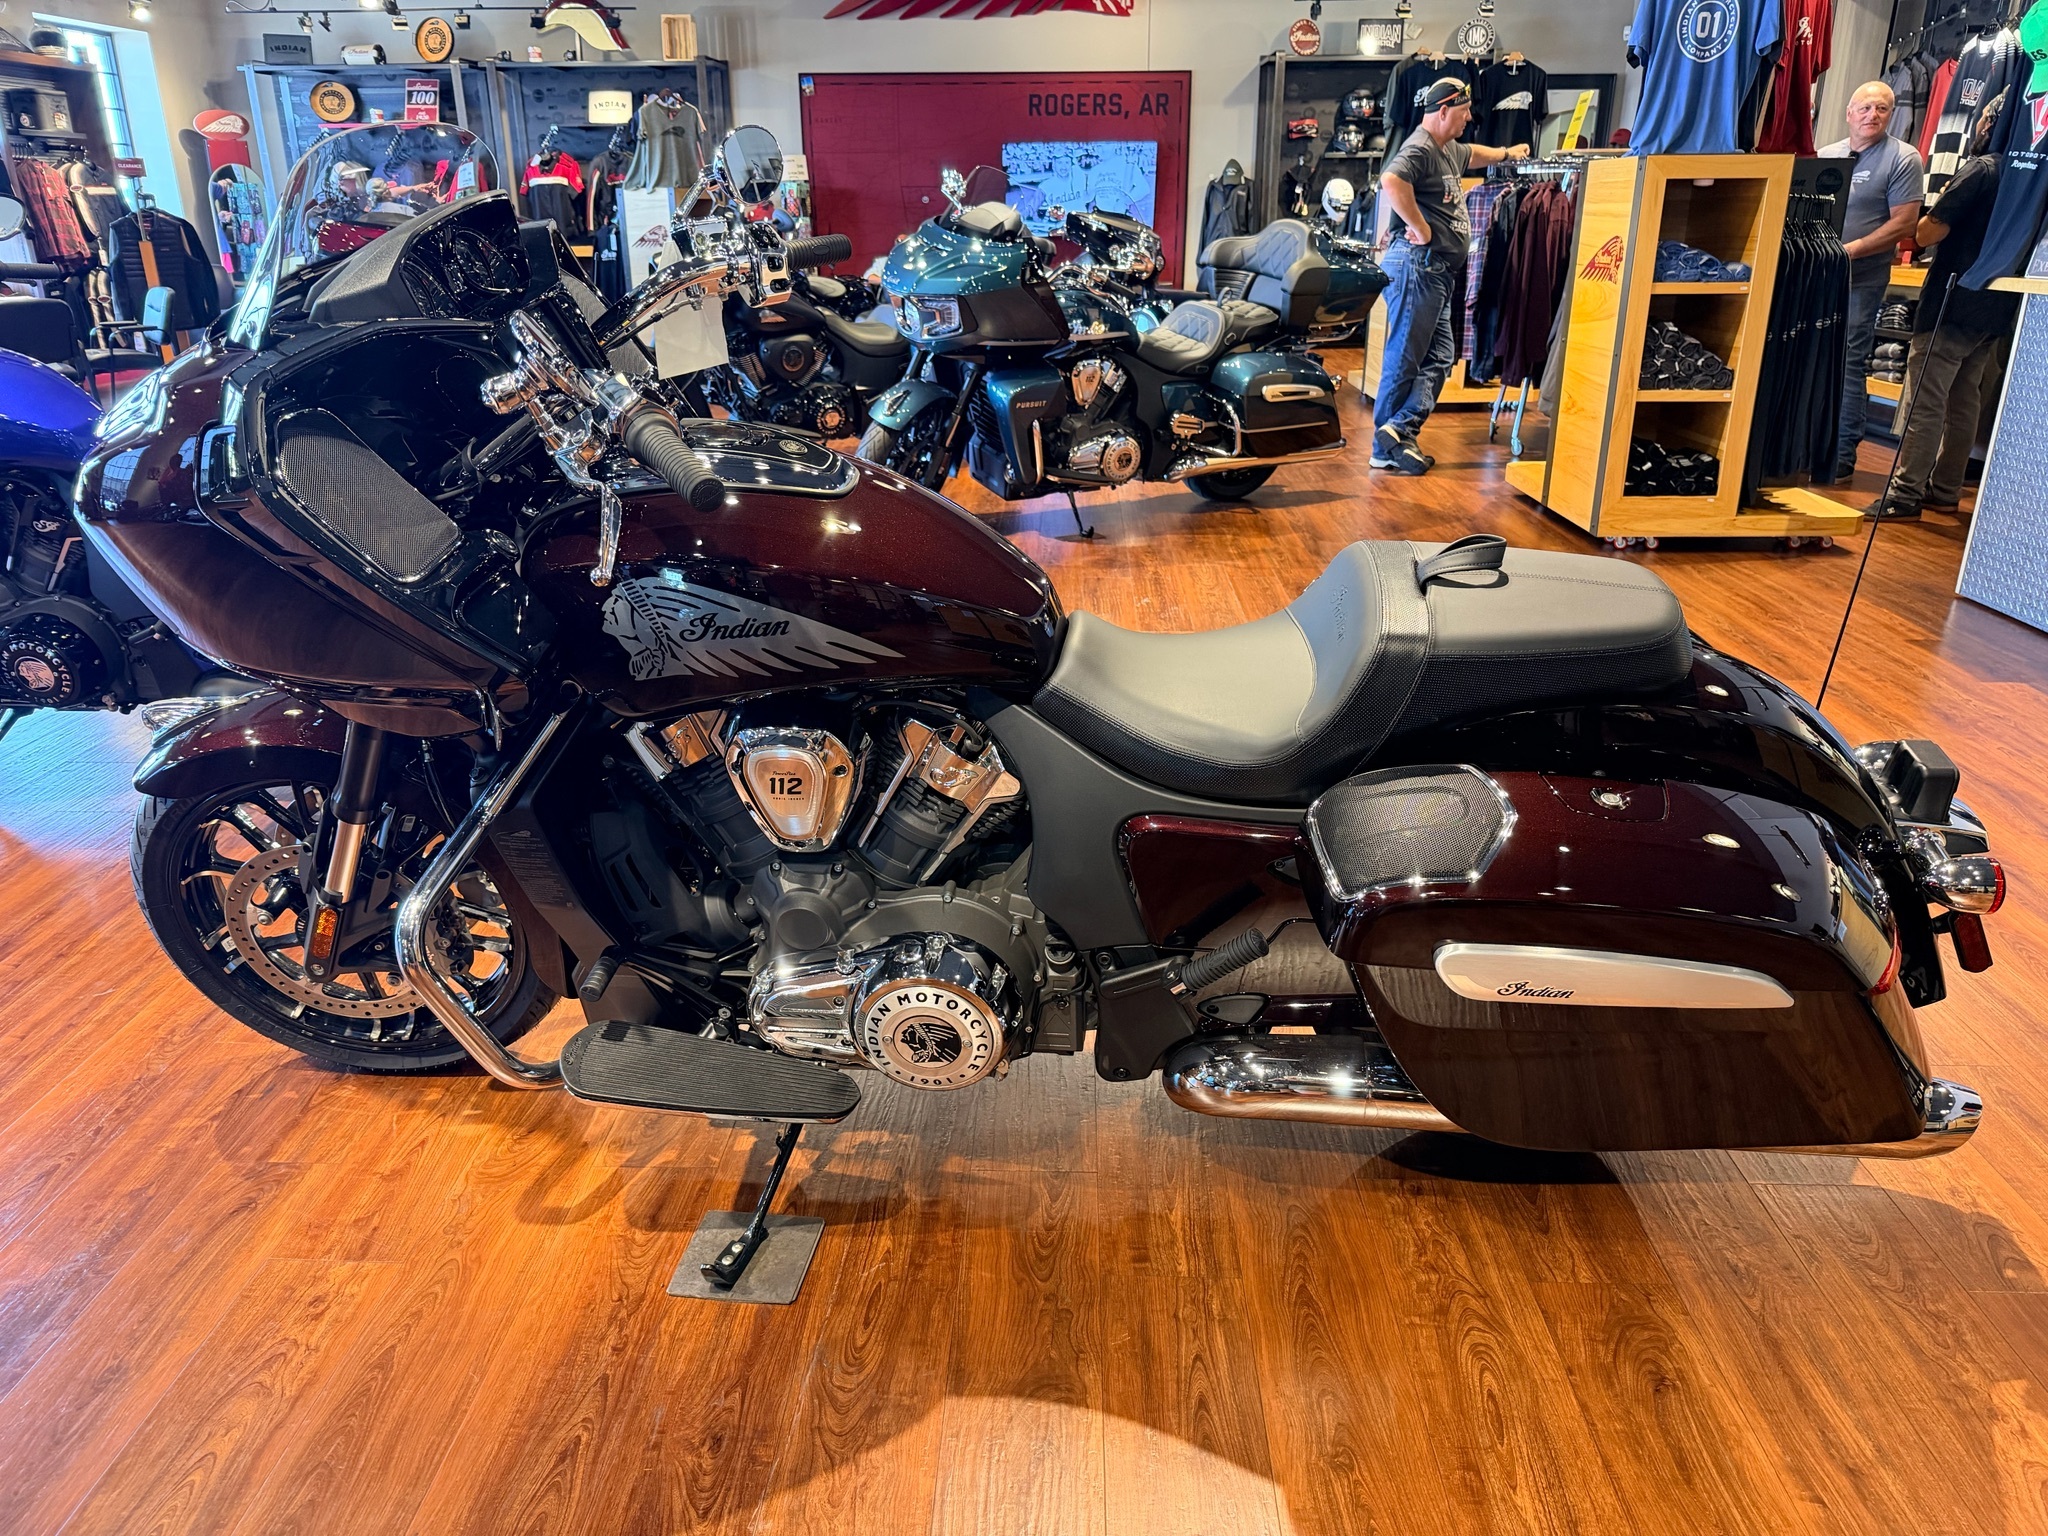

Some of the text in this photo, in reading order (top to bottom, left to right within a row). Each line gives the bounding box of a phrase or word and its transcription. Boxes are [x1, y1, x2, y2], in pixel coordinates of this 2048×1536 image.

[1361, 24, 1401, 43] INDIAN
[1696, 11, 1721, 38] 01
[1290, 30, 1320, 41] Indian
[269, 44, 307, 53] INDIAN
[1687, 44, 1722, 58] COMPANY
[410, 91, 436, 105] 100
[593, 101, 627, 110] INDIAN
[1028, 92, 1170, 119] ROGERS, AR
[1016, 400, 1047, 409] PURSUIT
[679, 612, 791, 643] Indian
[9, 642, 72, 693] MOTORCYCLE
[769, 777, 803, 795] 112
[1496, 980, 1574, 999] Indian
[867, 992, 990, 1072] INDIAN MOTORCYCLE
[910, 1075, 954, 1086] 1901
